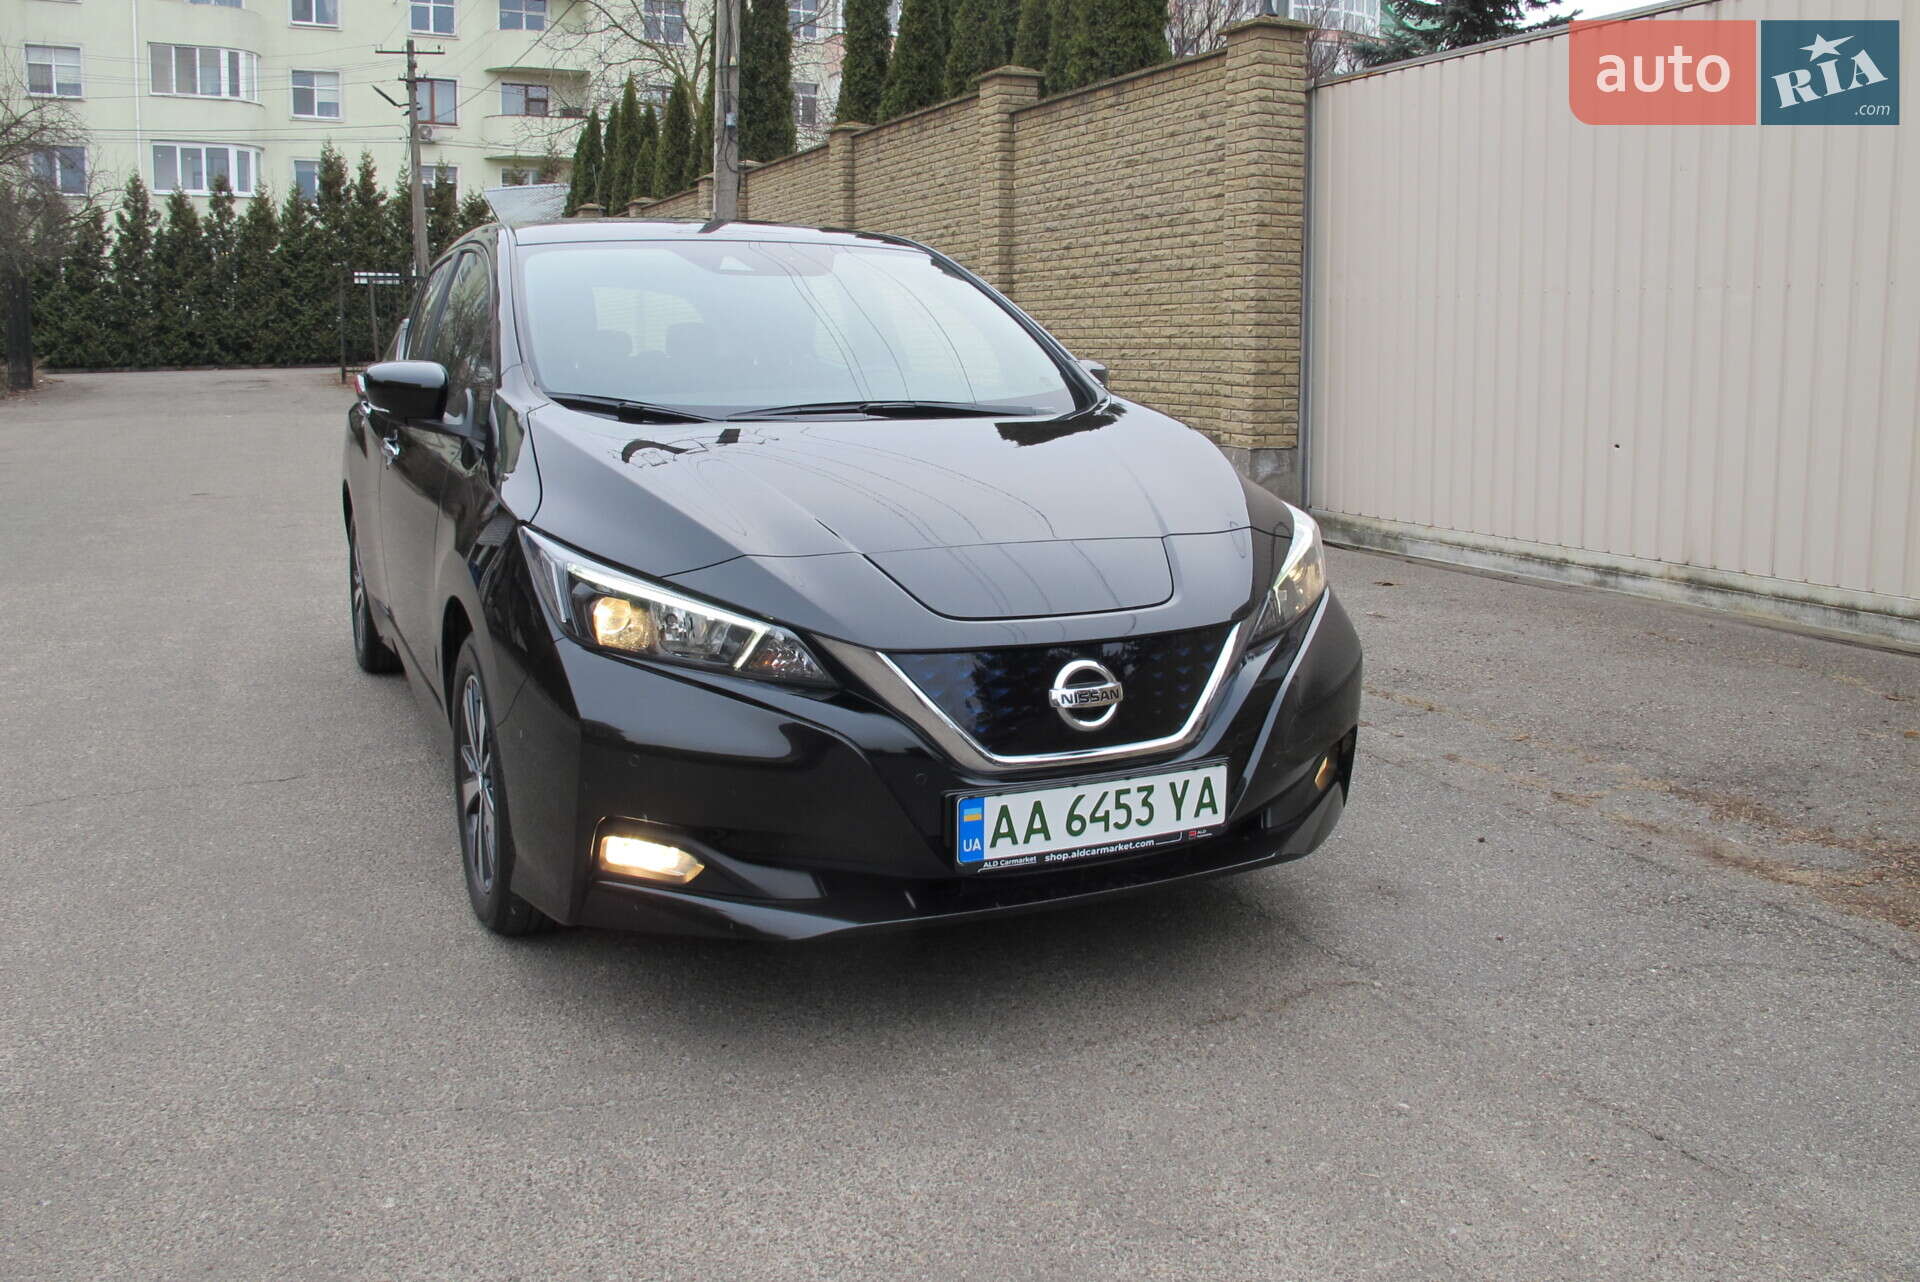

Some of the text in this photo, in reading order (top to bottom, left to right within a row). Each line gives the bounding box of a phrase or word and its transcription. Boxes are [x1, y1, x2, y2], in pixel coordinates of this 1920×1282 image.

[1060, 688, 1120, 705] NISSAN
[989, 776, 1219, 848] AA 6453 YA
[962, 838, 982, 852] UA
[1044, 839, 1155, 862] shop.aldcarmarket.com
[983, 856, 1037, 869] ALD Carmarket
